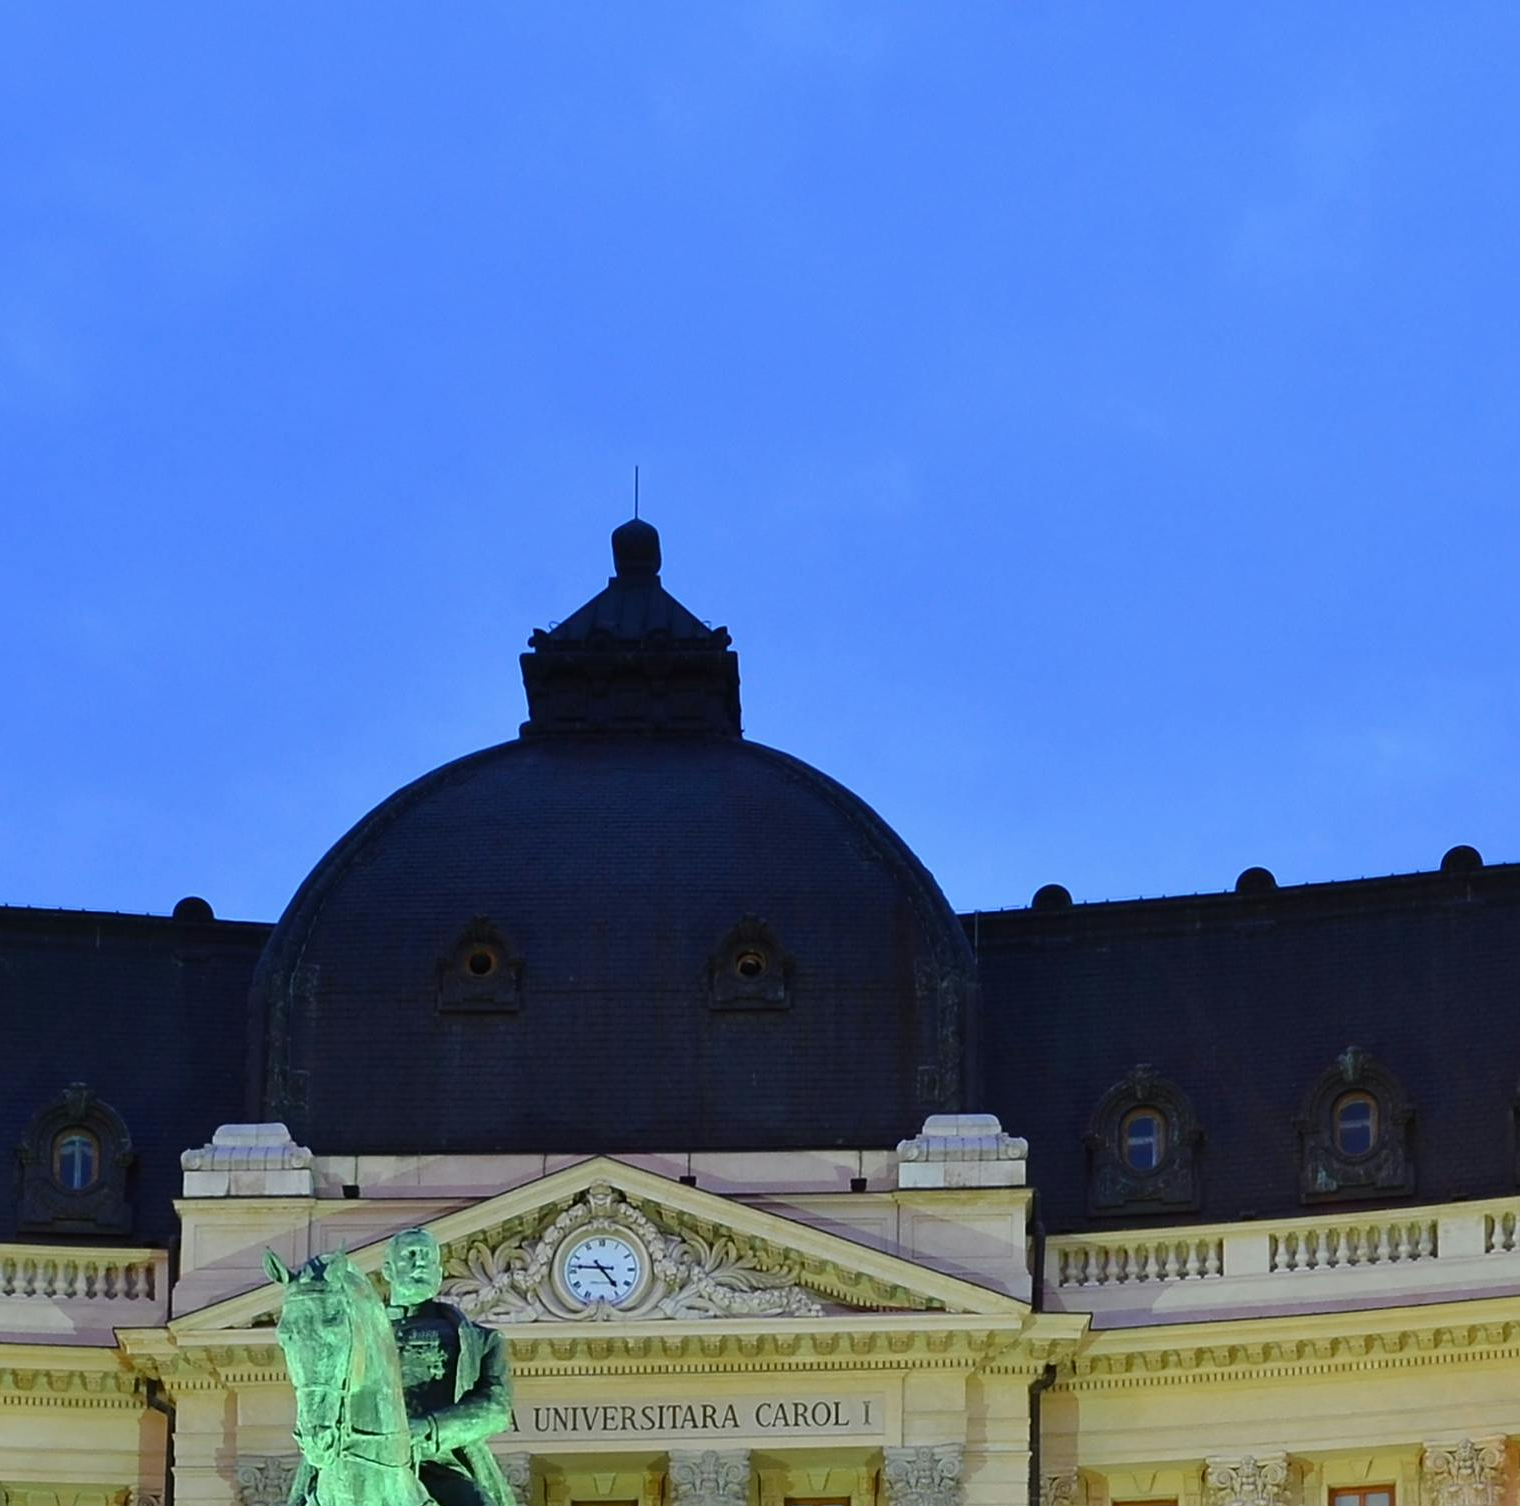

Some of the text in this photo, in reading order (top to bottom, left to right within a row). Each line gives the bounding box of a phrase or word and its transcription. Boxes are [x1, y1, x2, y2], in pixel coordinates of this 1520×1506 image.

[533, 1404, 740, 1432] UNIVERSITARA
[754, 1400, 850, 1428] CAROL
[862, 1400, 872, 1426] I
